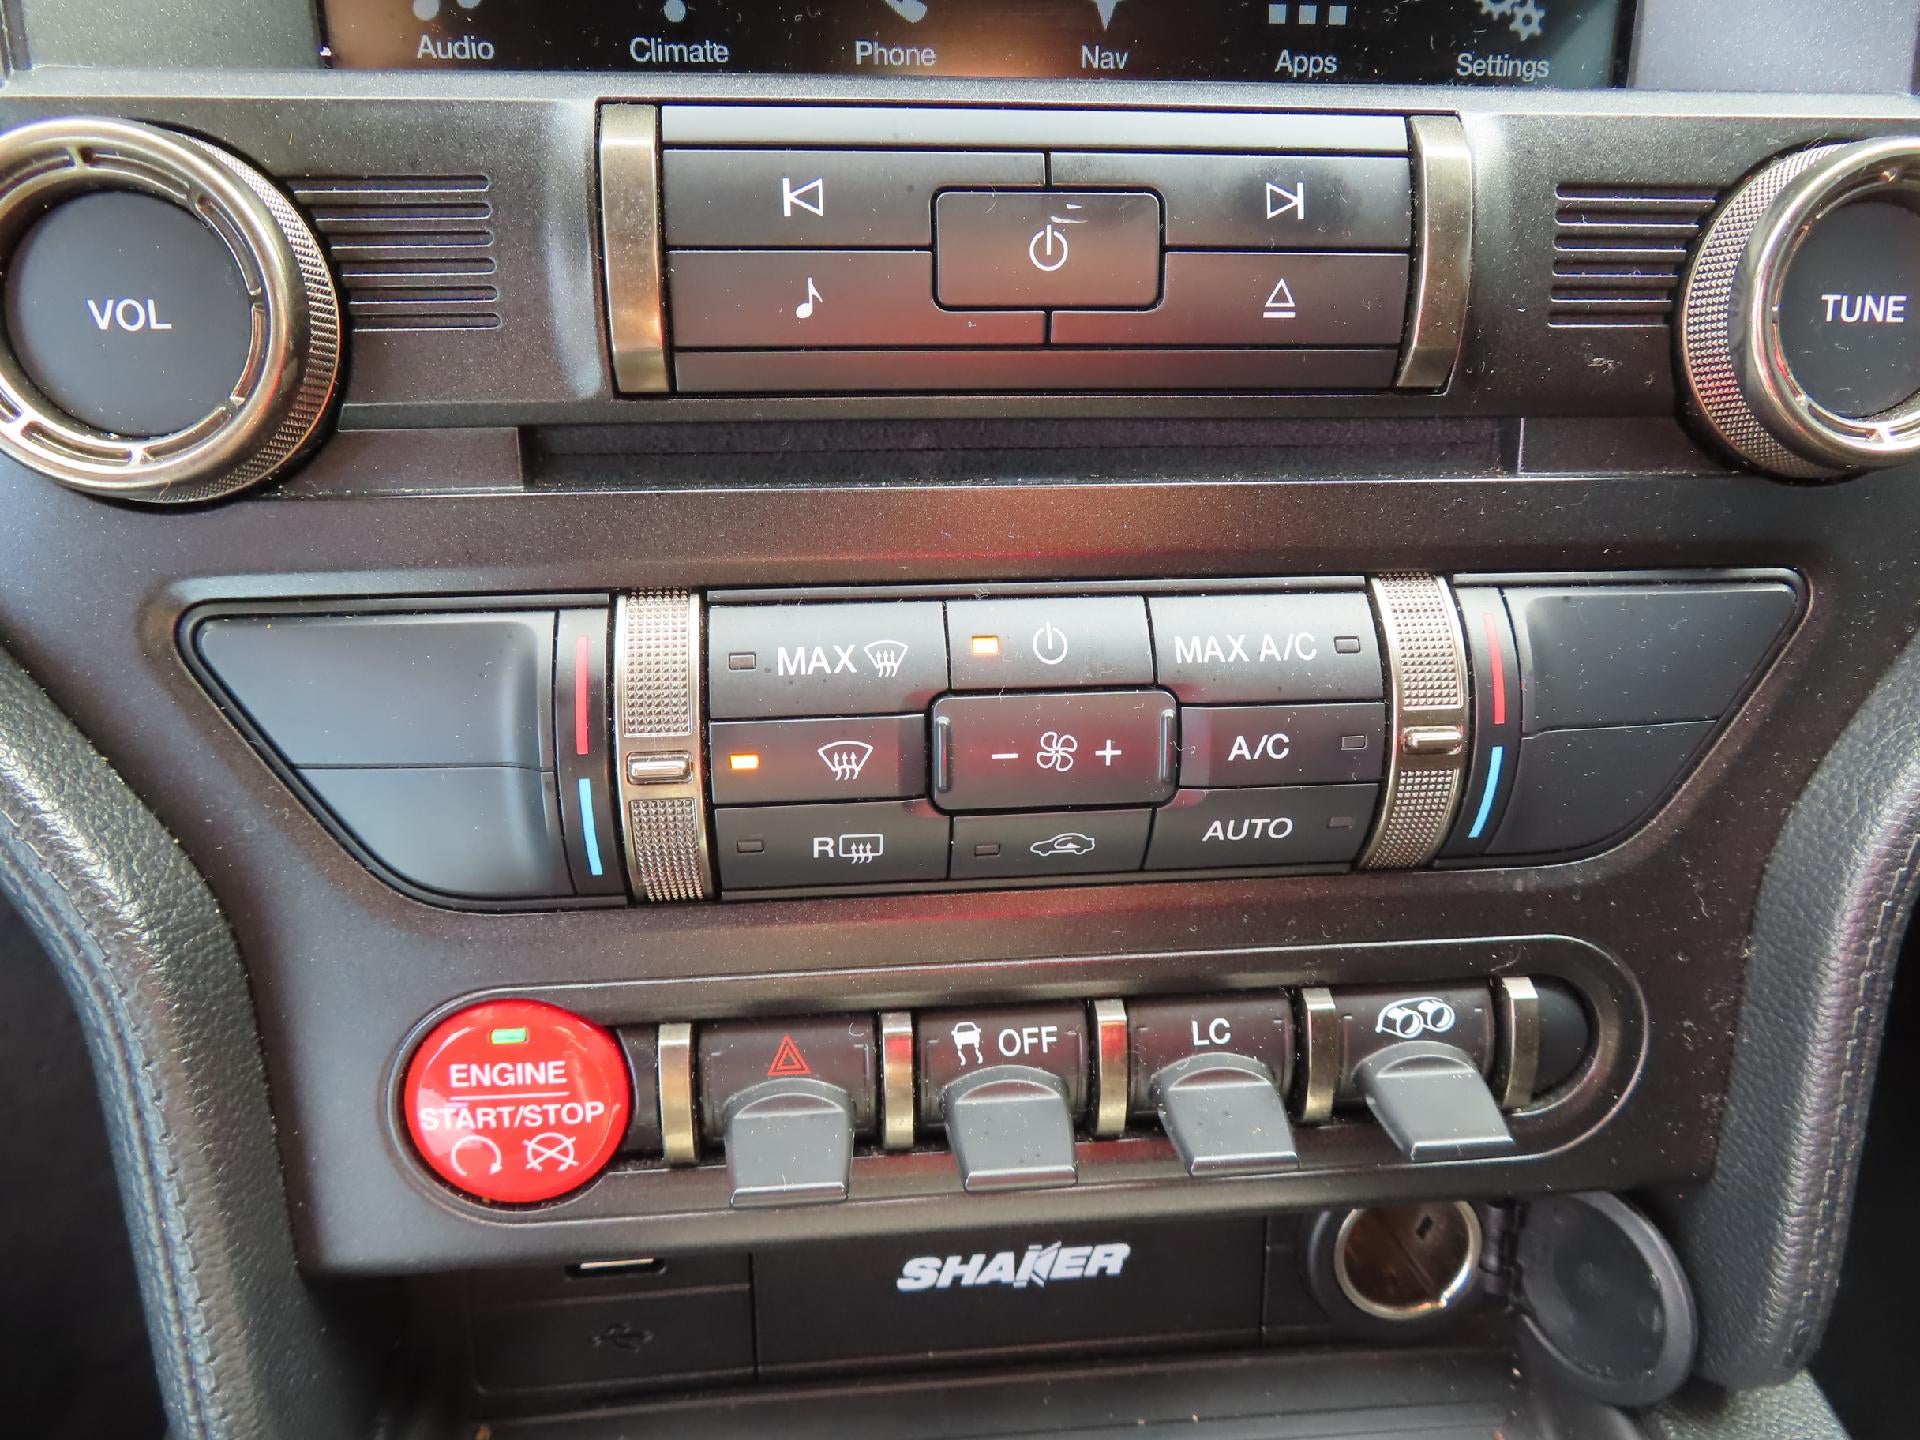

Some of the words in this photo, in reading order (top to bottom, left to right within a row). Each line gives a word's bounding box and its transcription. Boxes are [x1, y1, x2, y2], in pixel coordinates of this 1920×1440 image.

[416, 35, 495, 62] Audio
[629, 37, 729, 65] Climate
[855, 41, 937, 68] Phone
[1080, 44, 1129, 71] Nav
[1275, 48, 1338, 77] Apps
[1456, 51, 1550, 81] Settings
[87, 298, 172, 332] VOL
[1821, 293, 1906, 324] TUNE
[777, 644, 856, 677] MAX
[1174, 634, 1249, 664] MAX
[1259, 631, 1318, 662] A/C
[1227, 733, 1290, 762] A/C
[1202, 816, 1294, 842] AUTO
[812, 837, 834, 858] R
[998, 1025, 1058, 1057] OFF
[1190, 1018, 1233, 1047] LC
[449, 1060, 568, 1087] ENGINE
[420, 1102, 605, 1131] START/STOP
[896, 1241, 1131, 1292] SHAKER
